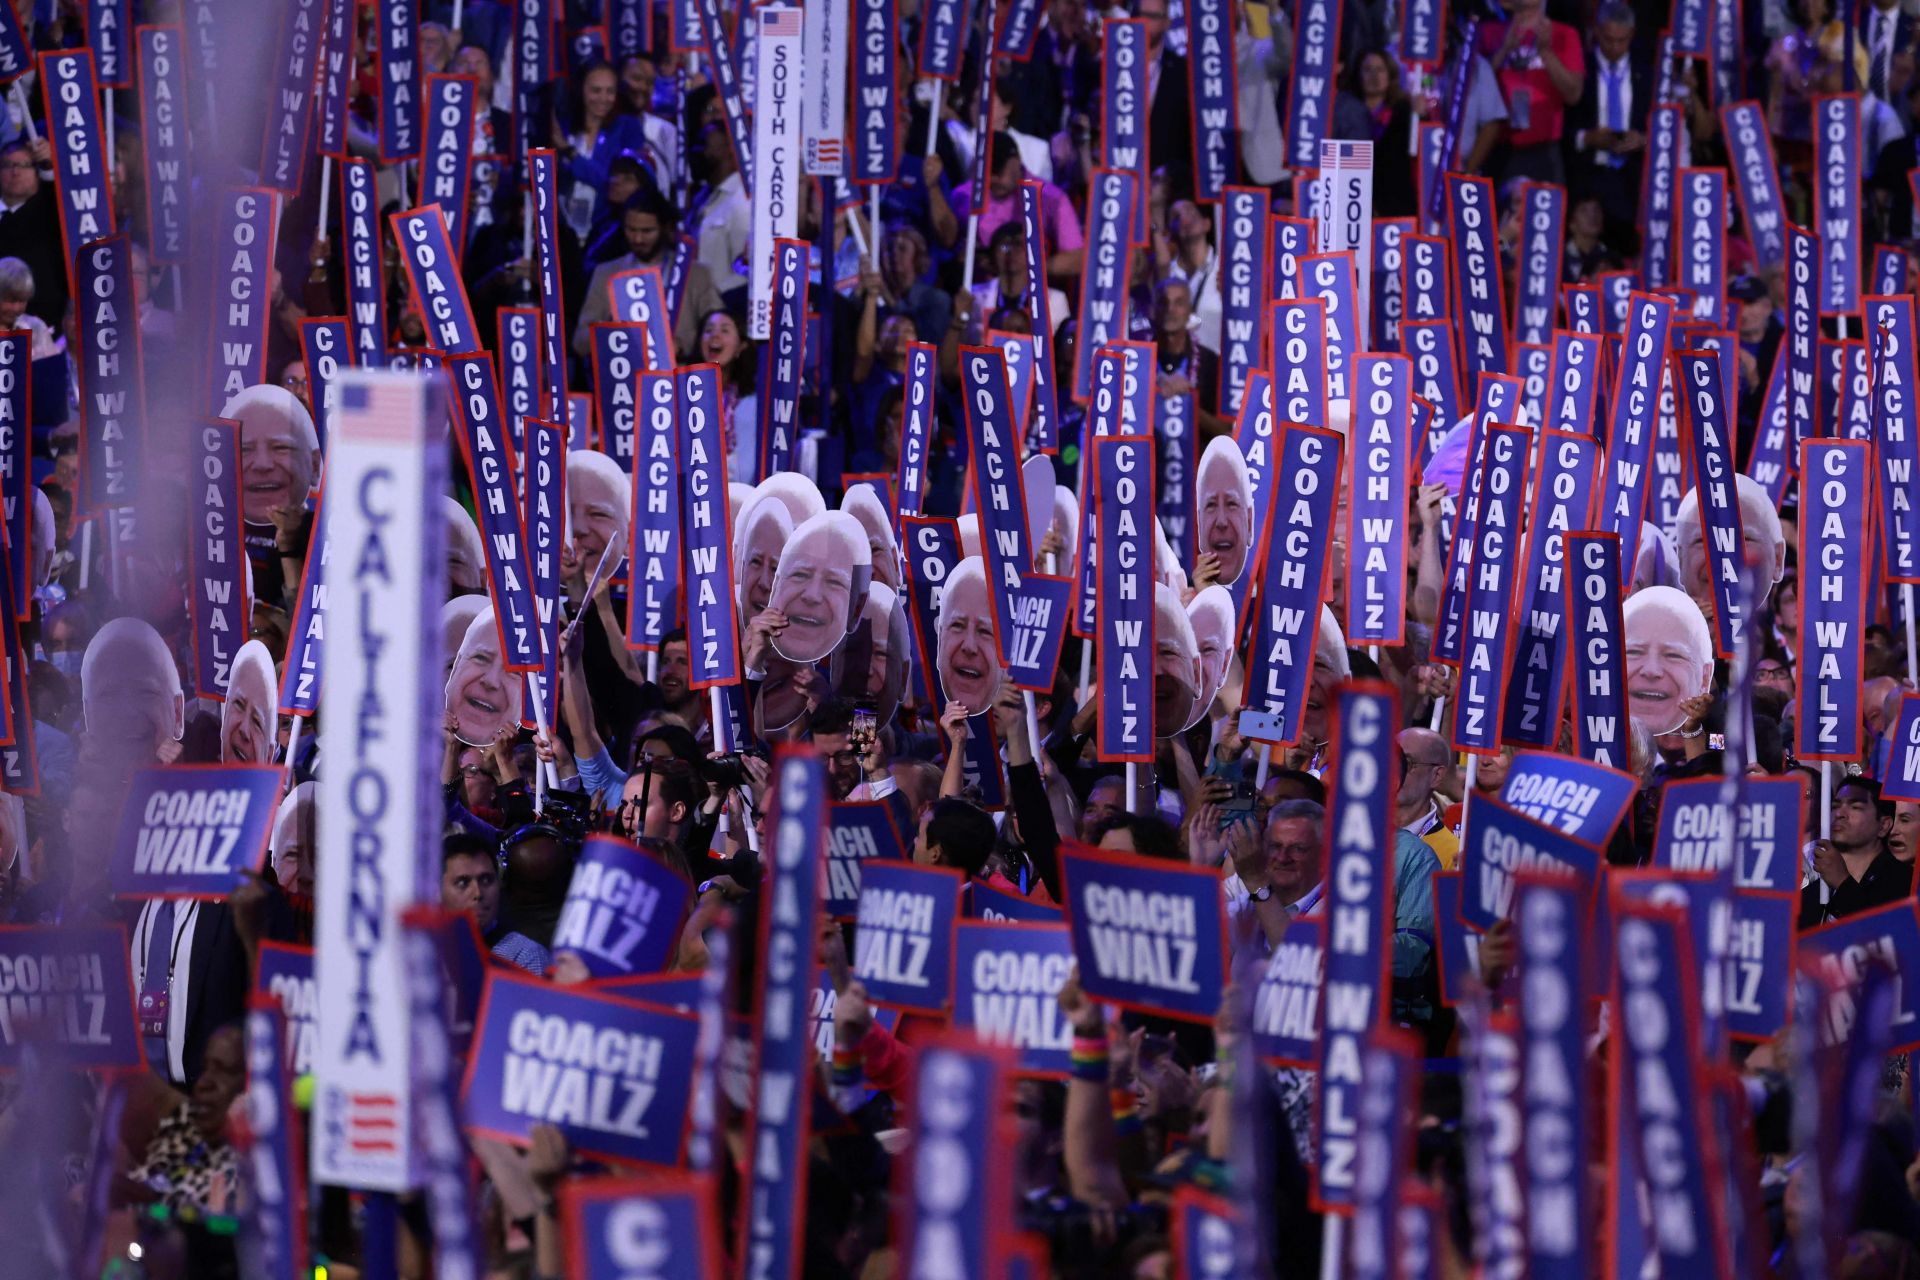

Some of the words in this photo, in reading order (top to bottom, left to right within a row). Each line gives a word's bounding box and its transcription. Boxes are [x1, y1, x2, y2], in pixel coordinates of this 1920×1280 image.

[98, 0, 117, 75] ALZ
[197, 6, 217, 69] ALZ
[522, 0, 540, 83] OACH
[932, 3, 955, 69] ALZ
[1116, 24, 1135, 135] COACH
[1413, 0, 1432, 54] ALZ
[57, 57, 90, 175] COACH
[151, 32, 174, 147] COACH
[275, 88, 303, 181] WALZ
[322, 52, 343, 144] WALZ
[389, 61, 412, 151] WALZ
[435, 82, 463, 197] COACH
[773, 44, 788, 135] SOUTH
[862, 86, 887, 173] WALZ
[1297, 76, 1325, 162] WALZ
[474, 161, 495, 226] COA
[1201, 108, 1228, 193] WALZ
[1653, 109, 1673, 211] COACH
[1735, 107, 1770, 204] COACH
[1827, 100, 1846, 209] COACH
[71, 187, 99, 244] WA
[157, 161, 179, 253] WALZ
[228, 196, 256, 327] COACH
[350, 166, 371, 287] COACH
[767, 147, 787, 291] CAROL
[1096, 175, 1121, 289] COACH
[1231, 193, 1254, 308] COACH
[1346, 177, 1362, 250] SOU
[1460, 183, 1488, 299] COACH
[1529, 189, 1552, 296] COACH
[1648, 220, 1669, 289] WAL
[1693, 174, 1712, 285] COACH
[92, 247, 119, 378] COACH
[408, 218, 461, 346] COACH
[776, 248, 798, 383] COACH
[1281, 225, 1297, 300] COA
[1415, 243, 1435, 316] COA
[1794, 235, 1809, 359] COACH
[1826, 220, 1849, 306] WALZ
[222, 342, 253, 393] WA
[356, 302, 377, 373] WAL
[1090, 301, 1115, 345] WA
[1286, 308, 1309, 422] COAC
[1525, 306, 1548, 344] WA
[1623, 303, 1657, 446] COACH
[607, 331, 635, 458] COACH
[772, 401, 793, 476] WAL
[905, 352, 927, 493] COACH
[1096, 360, 1113, 437] COA
[1367, 361, 1393, 502] COACH
[1559, 340, 1584, 433] COA
[95, 391, 126, 494] WALZ
[202, 428, 226, 564] COACH
[648, 379, 674, 514] COACH
[686, 375, 712, 529] COACH
[971, 357, 1010, 511] COACH
[995, 529, 1022, 621] WAL
[1164, 396, 1183, 505] COACH
[1613, 460, 1641, 533] WA
[464, 362, 507, 516] COACH
[493, 533, 532, 655] WALZ
[536, 429, 551, 579] COACH
[1114, 445, 1137, 601] COACH
[1281, 437, 1323, 590] COACH
[1480, 434, 1513, 592] COACH
[1540, 442, 1580, 593] COACH
[1693, 361, 1728, 508] COACH
[1712, 526, 1744, 643] WALZ
[1821, 449, 1848, 603] COACH
[1887, 458, 1913, 568] WALZ
[644, 529, 671, 636] WALZ
[692, 547, 719, 669] WALZ
[918, 527, 946, 612] COA
[1362, 518, 1394, 630] WALZ
[1443, 537, 1473, 649] WALZ
[1584, 543, 1611, 696] COACH
[204, 578, 232, 688] WALZ
[1114, 620, 1143, 744] WALZ
[1466, 610, 1500, 735] WALZ
[1520, 610, 1560, 732] WALZ
[1815, 621, 1848, 744] WALZ
[340, 466, 396, 1062] CALIFORNIA
[1587, 716, 1616, 767] WA
[132, 827, 241, 875] WALZ
[143, 789, 252, 827] COACH
[1333, 696, 1382, 957] COACH
[1506, 773, 1601, 820] COACH
[1083, 881, 1197, 939] COACH
[1086, 923, 1201, 995] WALZ
[972, 993, 1074, 1050] WAL
[973, 950, 1076, 993] COAC
[501, 1053, 657, 1139] WALZ
[509, 1009, 665, 1080] COACH
[1321, 980, 1374, 1189] WALZ
